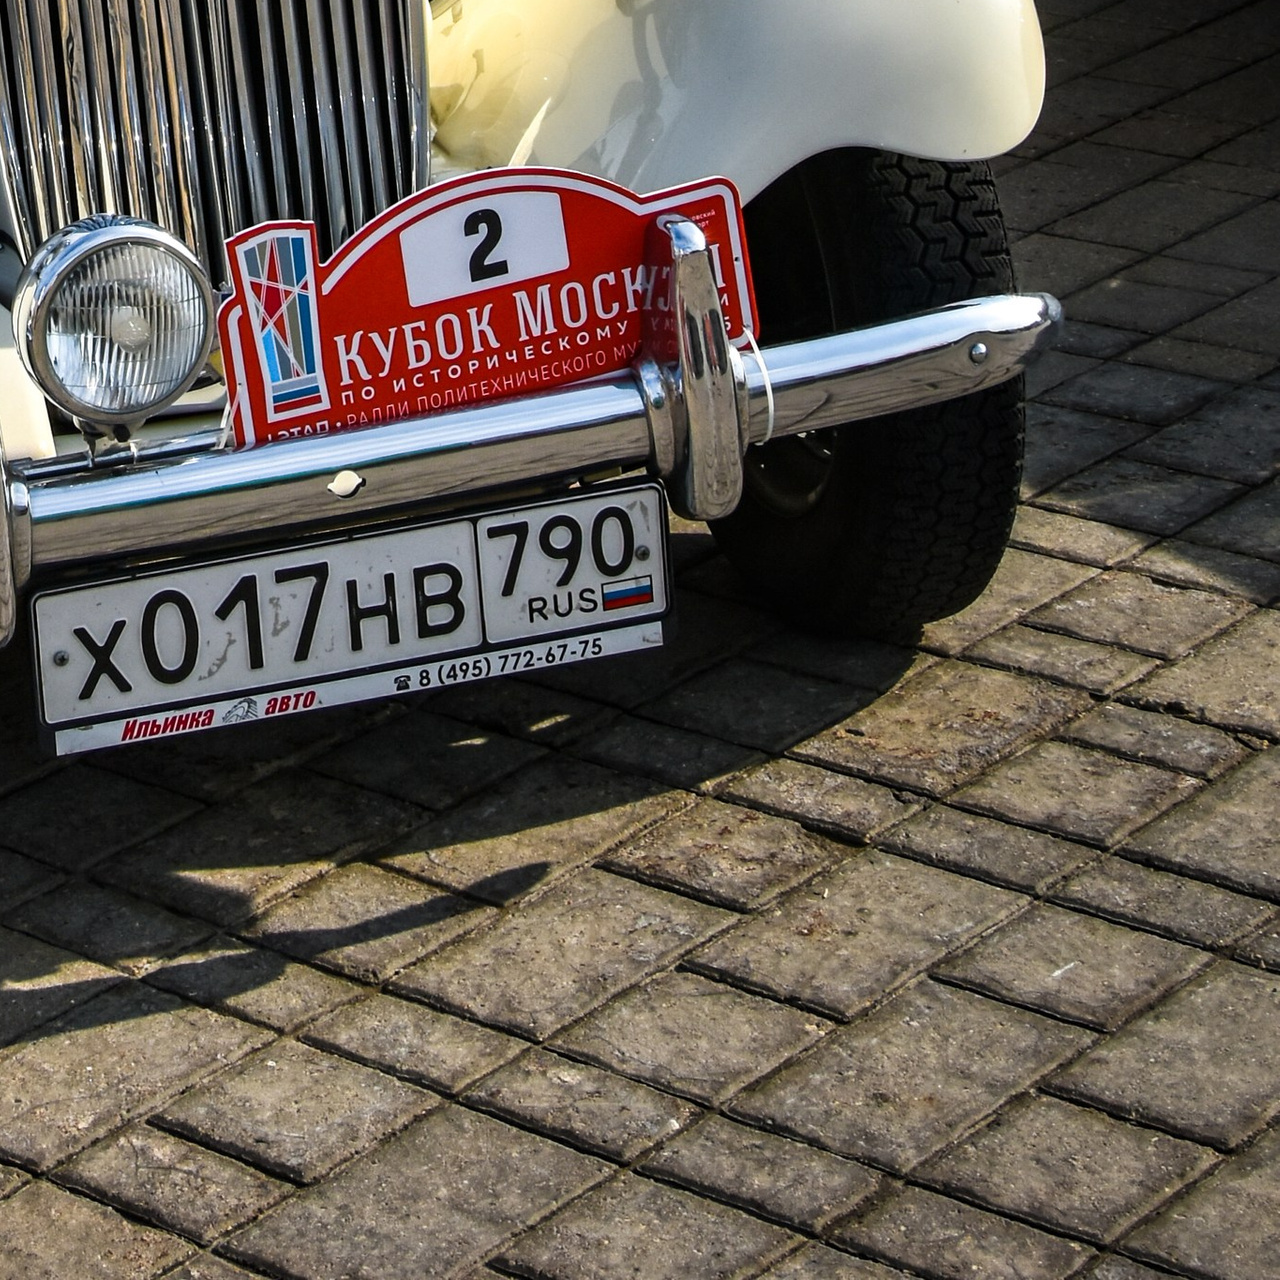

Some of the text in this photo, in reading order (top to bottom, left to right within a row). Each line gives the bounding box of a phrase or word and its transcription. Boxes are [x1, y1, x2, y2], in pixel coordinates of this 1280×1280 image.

[462, 208, 509, 283] 2
[334, 303, 500, 386] КУБОК
[341, 386, 375, 406] ПО
[393, 320, 629, 394] ИСТОРИЧЕСКОМУ
[347, 401, 409, 425] РАЛЛИ
[416, 350, 607, 411] ПОЛИТЕХНИЧЕСКОГО
[487, 506, 634, 597] 790
[528, 588, 598, 623] RUS
[418, 638, 604, 688] 8 (495) 772-67-75
[121, 690, 317, 741] Ильинка авто
